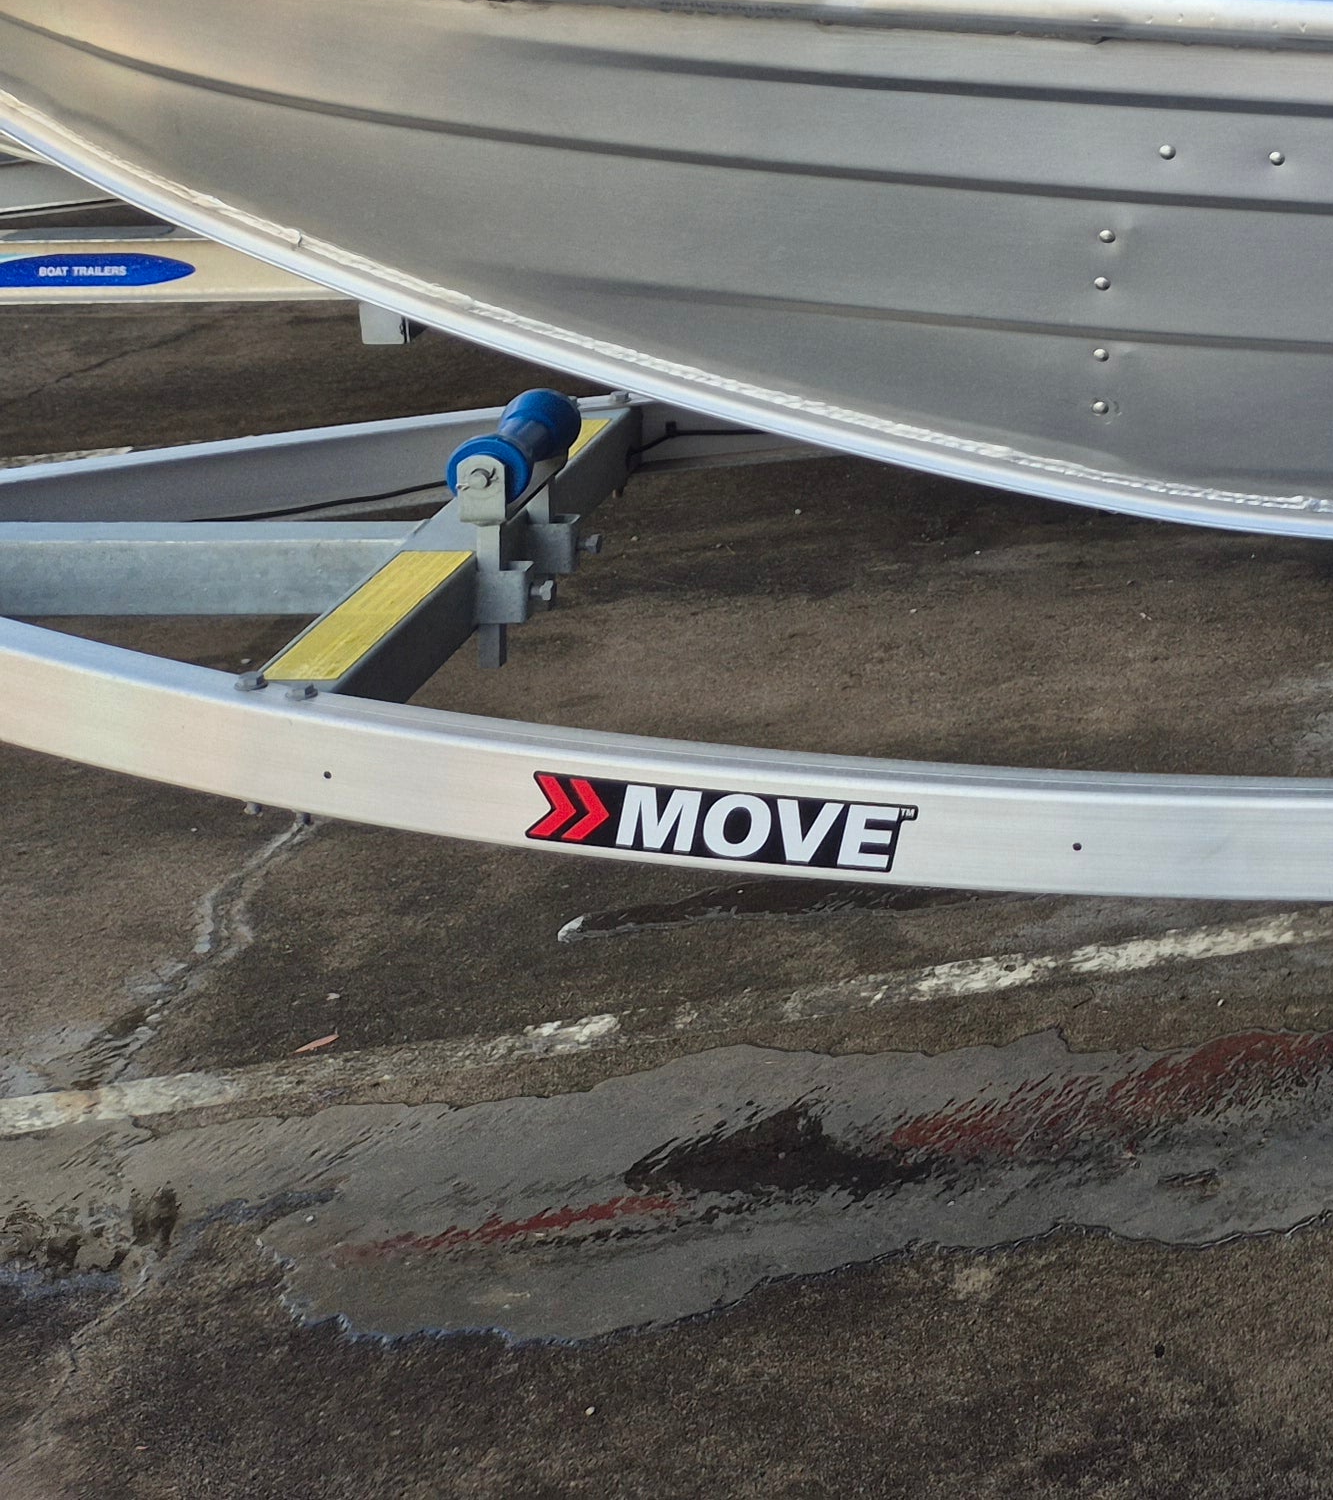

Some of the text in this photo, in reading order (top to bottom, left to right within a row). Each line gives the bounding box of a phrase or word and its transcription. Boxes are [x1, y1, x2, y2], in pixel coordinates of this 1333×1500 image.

[38, 266, 127, 277] BOAT TRAILERS
[615, 784, 900, 869] MOVE
